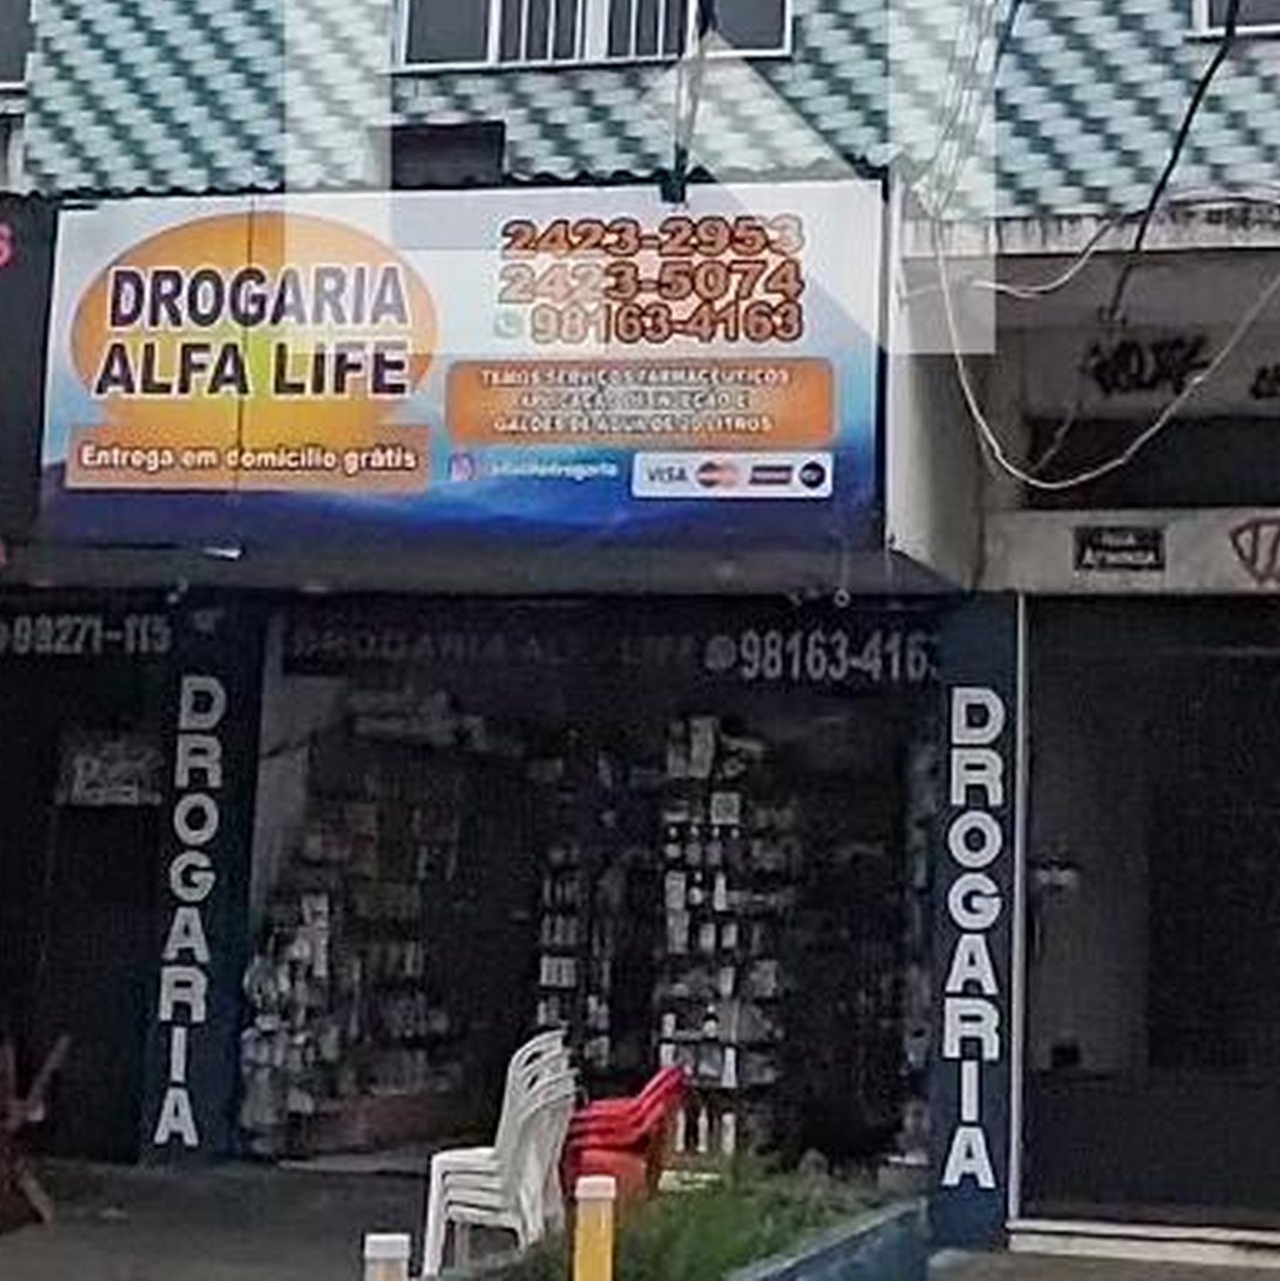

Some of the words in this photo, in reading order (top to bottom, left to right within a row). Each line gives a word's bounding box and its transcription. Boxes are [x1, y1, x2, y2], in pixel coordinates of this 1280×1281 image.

[501, 215, 805, 257] 2423-2953
[109, 266, 409, 328] DROGARIA
[499, 259, 806, 303] 2423-5074
[531, 301, 804, 344] 98163-4163
[95, 340, 250, 396] ALFA
[273, 339, 409, 396] LIFE
[81, 445, 174, 471] Entrega
[181, 449, 218, 468] em
[740, 627, 941, 681] 98163-416
[153, 674, 228, 1147] DROGARIA
[941, 685, 1007, 1189] DROGARIA
